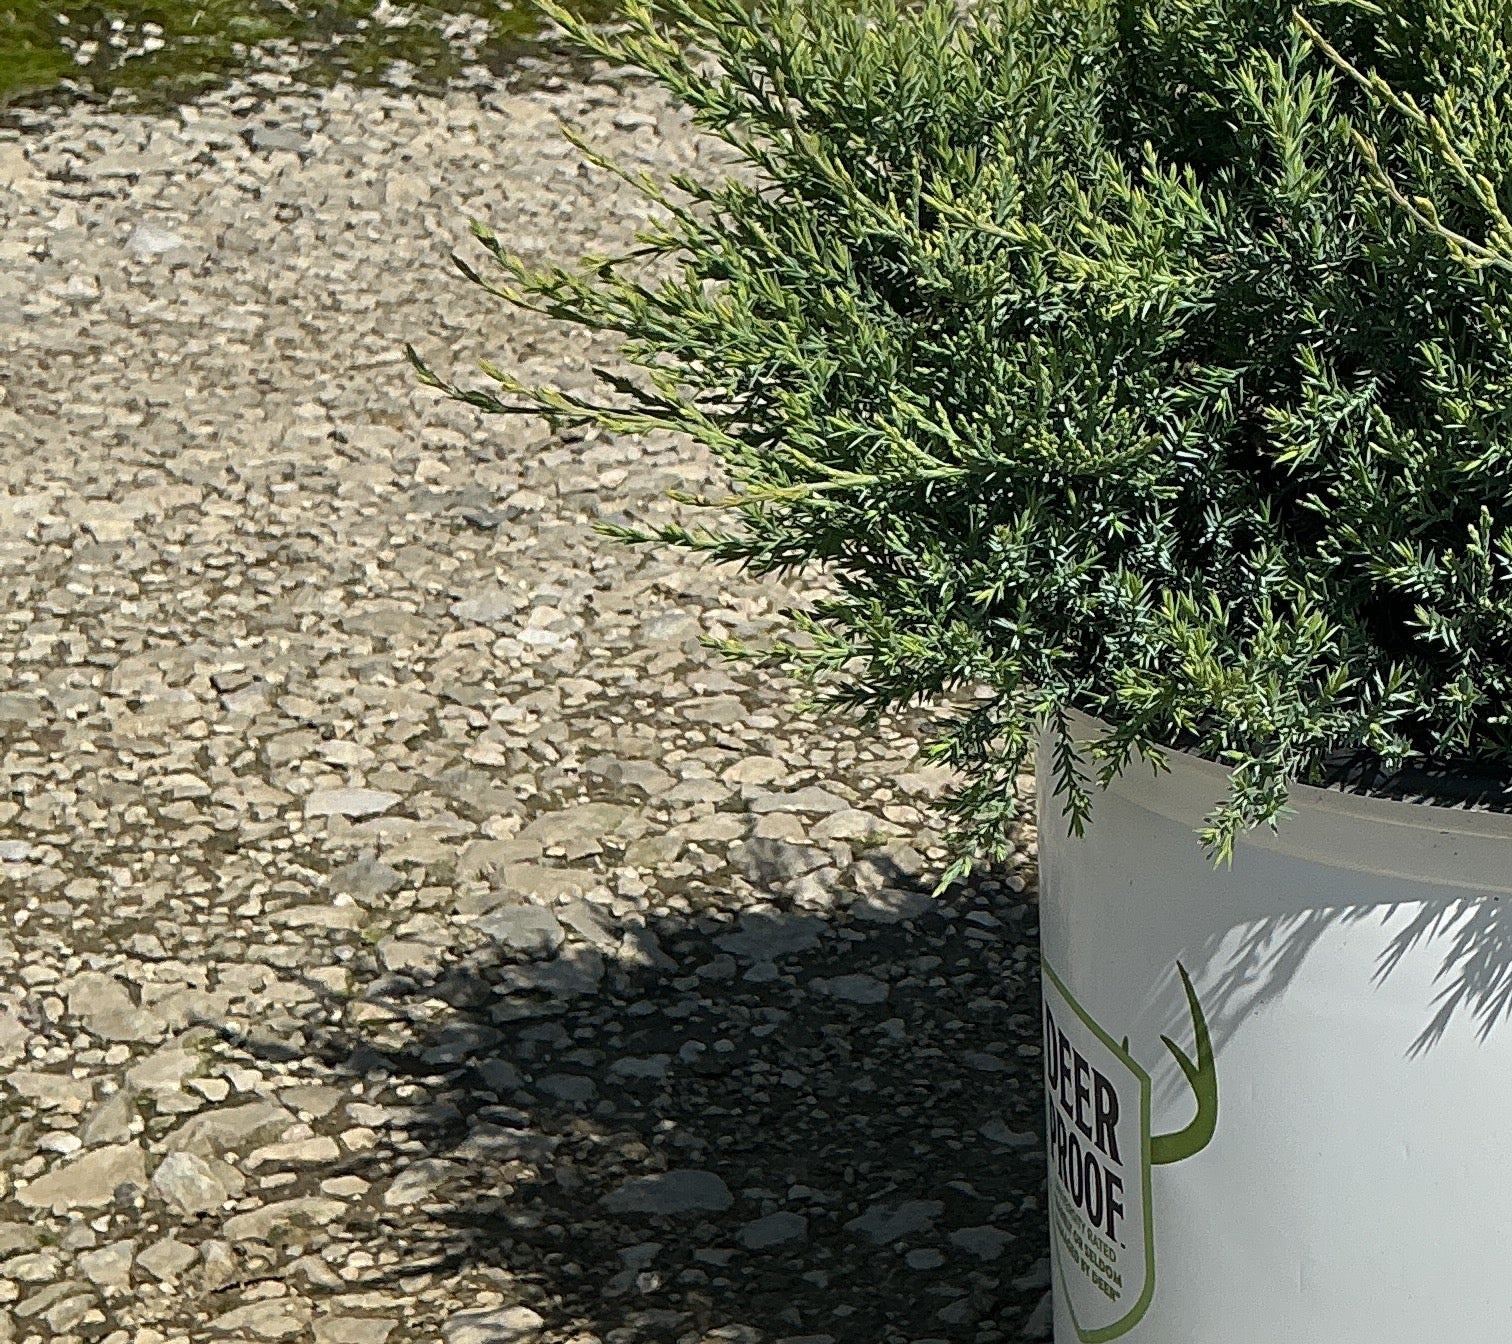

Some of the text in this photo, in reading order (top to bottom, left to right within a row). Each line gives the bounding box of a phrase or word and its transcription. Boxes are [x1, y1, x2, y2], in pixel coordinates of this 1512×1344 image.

[1045, 1000, 1124, 1167] DEER
[1050, 1090, 1125, 1243] PROOF
[1087, 1228, 1117, 1263] RATED
